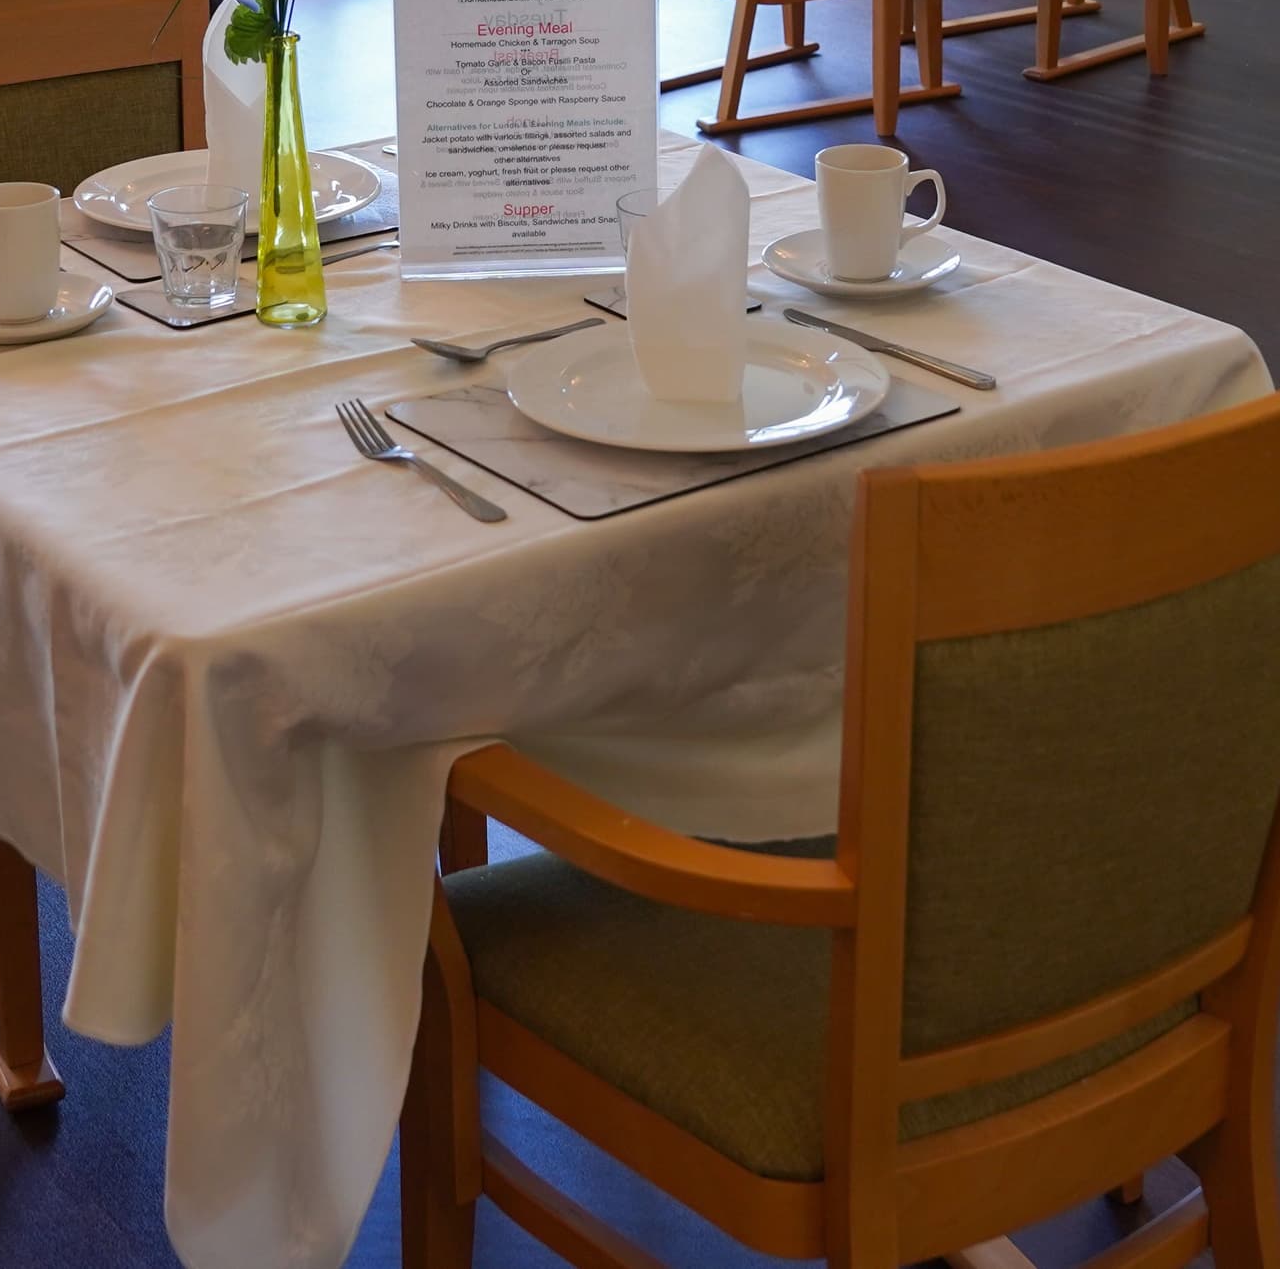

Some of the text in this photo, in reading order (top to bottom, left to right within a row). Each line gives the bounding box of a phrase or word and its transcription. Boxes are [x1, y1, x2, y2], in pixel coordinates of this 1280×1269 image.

[477, 21, 573, 38] Evening Meal
[451, 36, 600, 49] Homemade Chicken & Tarragon Soup
[456, 60, 486, 68] Tomato
[487, 59, 511, 67] Garlic
[521, 58, 546, 66] Bacon
[548, 57, 572, 65] Fusilli
[573, 56, 596, 64] Pasta
[521, 68, 532, 76] Or
[483, 77, 569, 87] Assorted Sandwiches
[426, 94, 627, 109] Chocolate & Orange Sponge with Raspberry Sauce
[427, 122, 477, 131] Alternatives
[479, 121, 491, 130] for
[566, 118, 591, 127] Meals
[422, 135, 448, 144] Jacket
[449, 134, 475, 143] potato
[476, 133, 492, 141] with
[493, 132, 523, 140] various
[553, 130, 588, 139] assorted
[588, 130, 615, 138] salads
[616, 129, 632, 137] and
[447, 145, 496, 154] sandwiches,
[548, 143, 575, 152] please
[576, 141, 607, 151] request
[494, 155, 561, 164] other alternatives
[425, 170, 438, 178] Ice
[439, 170, 467, 178] cream,
[468, 168, 500, 179] yoghurt,
[501, 168, 522, 176] fresh
[523, 167, 539, 175] fruit
[550, 166, 577, 175] please
[578, 165, 608, 174] request
[609, 164, 630, 172] other
[505, 178, 551, 187] alternatives
[503, 203, 555, 218] Supper
[431, 215, 619, 230] Milky Drinks with Biscuits, Sandwiches and Snac
[511, 229, 547, 238] available
